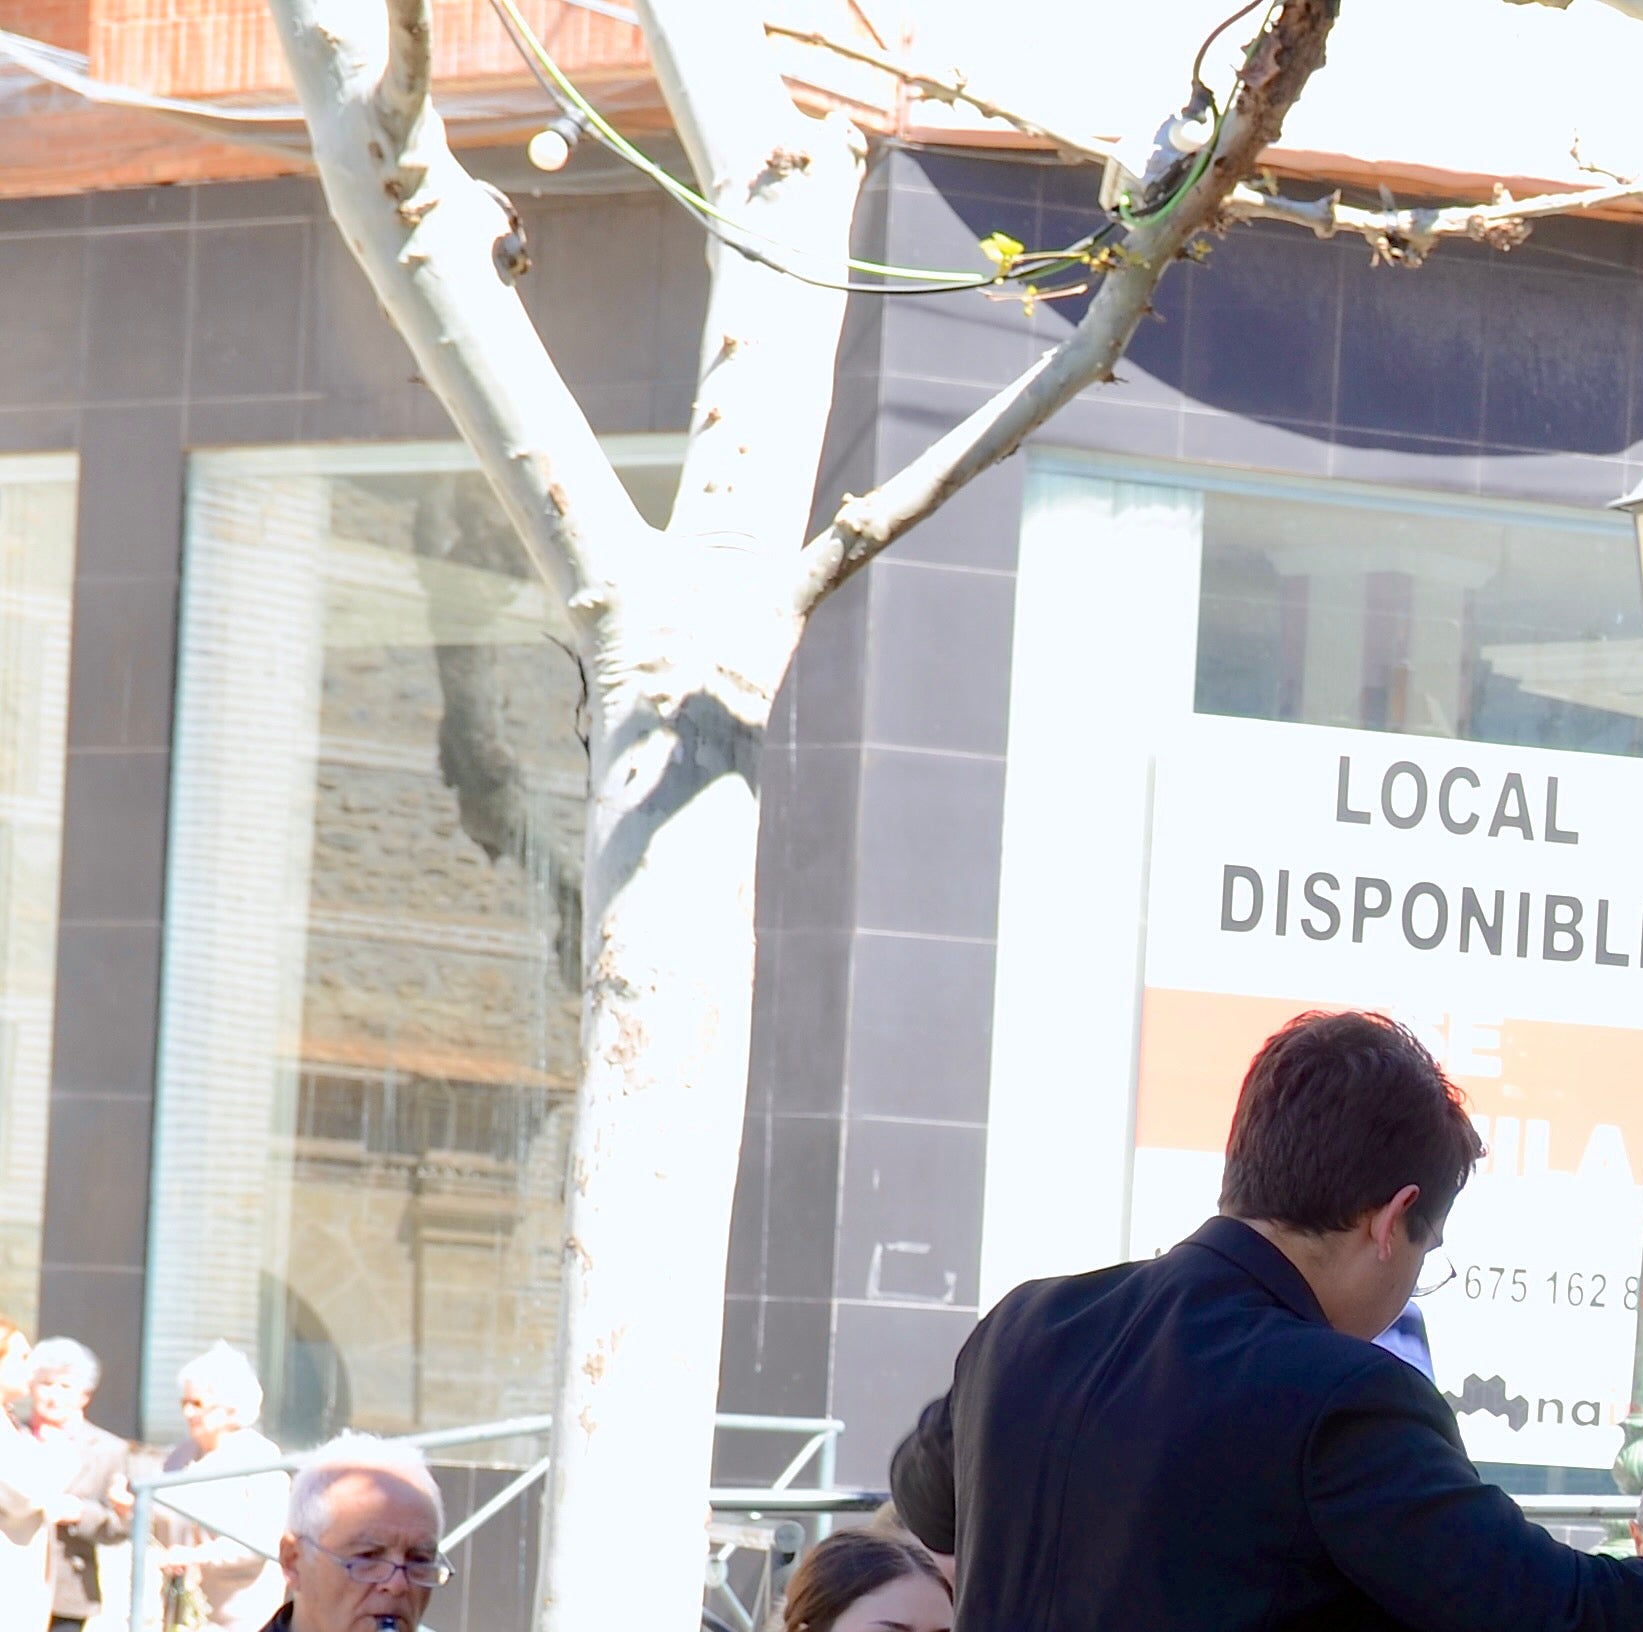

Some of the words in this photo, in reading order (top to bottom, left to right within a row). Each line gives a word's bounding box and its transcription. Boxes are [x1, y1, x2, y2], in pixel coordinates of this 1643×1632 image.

[1335, 755, 1580, 845] LOCAL
[1466, 1266, 1526, 1302] 675
[1547, 1272, 1606, 1307] 162
